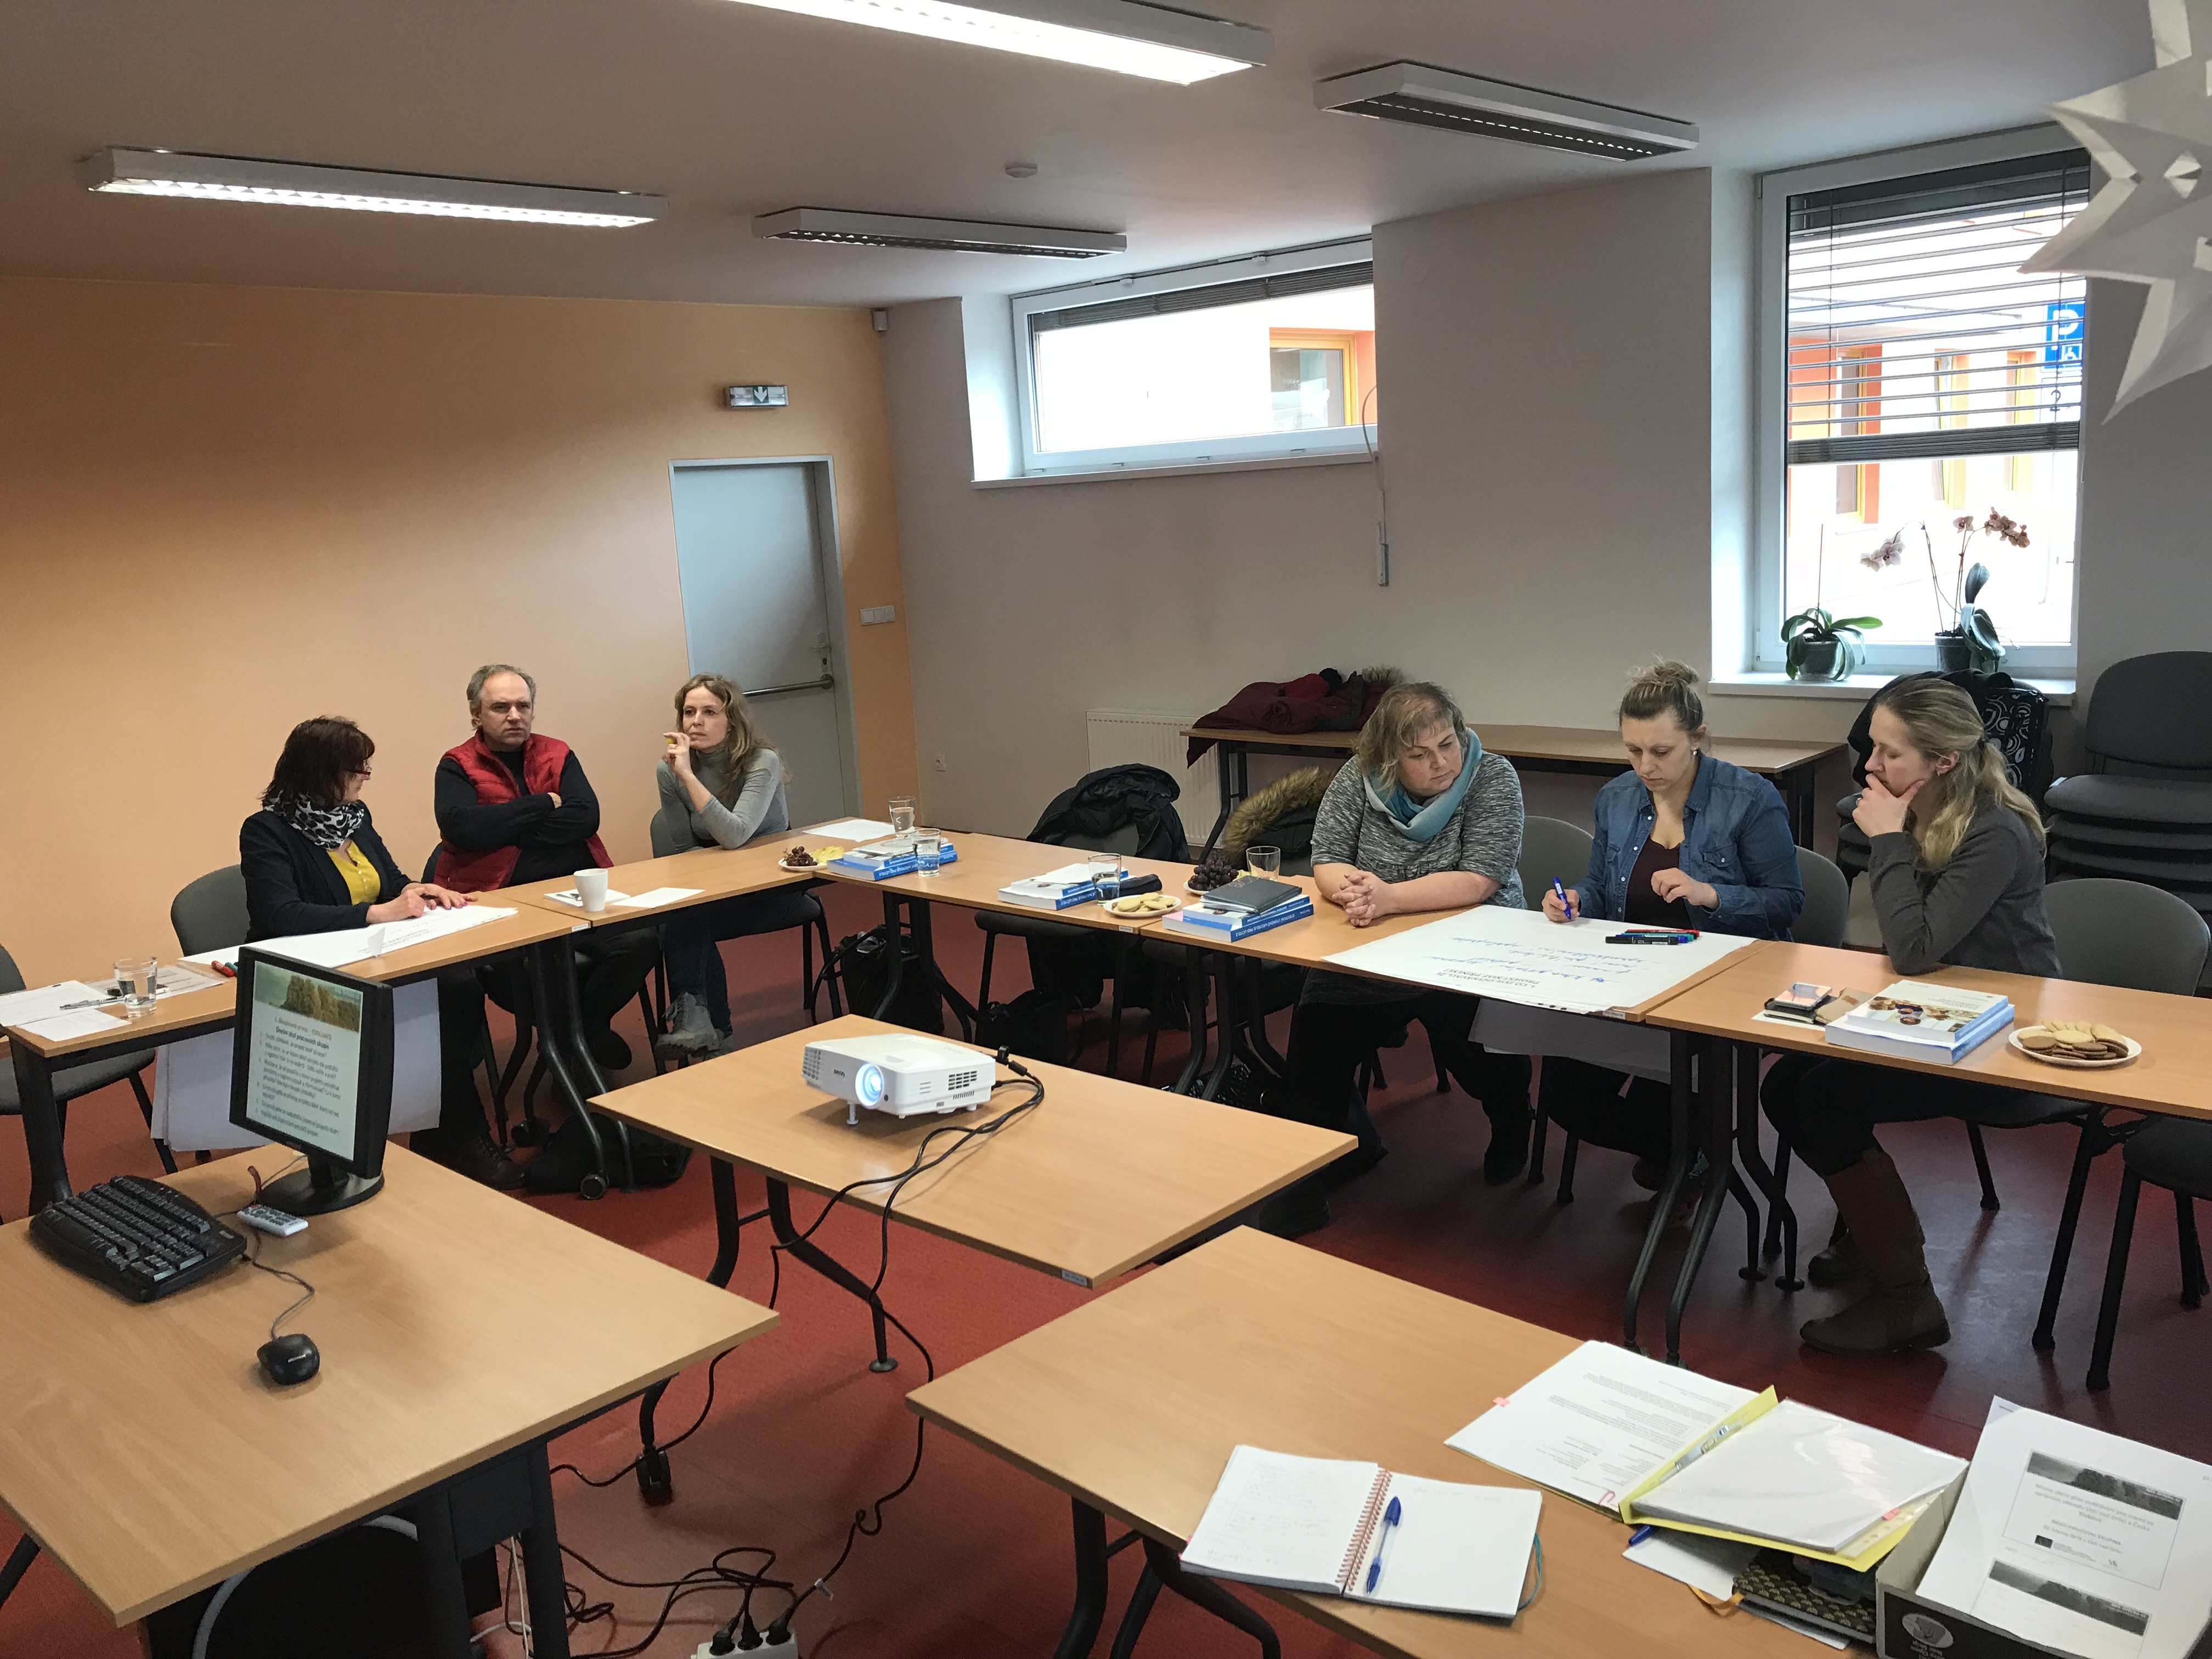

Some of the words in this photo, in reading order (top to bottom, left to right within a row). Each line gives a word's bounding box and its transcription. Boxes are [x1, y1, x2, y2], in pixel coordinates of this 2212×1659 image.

[2052, 310, 2079, 350] P
[1443, 968, 1481, 977] PŘINESE?
[1502, 975, 1541, 984] PROJEKT
[2097, 1534, 2121, 1545] SKUPINA
